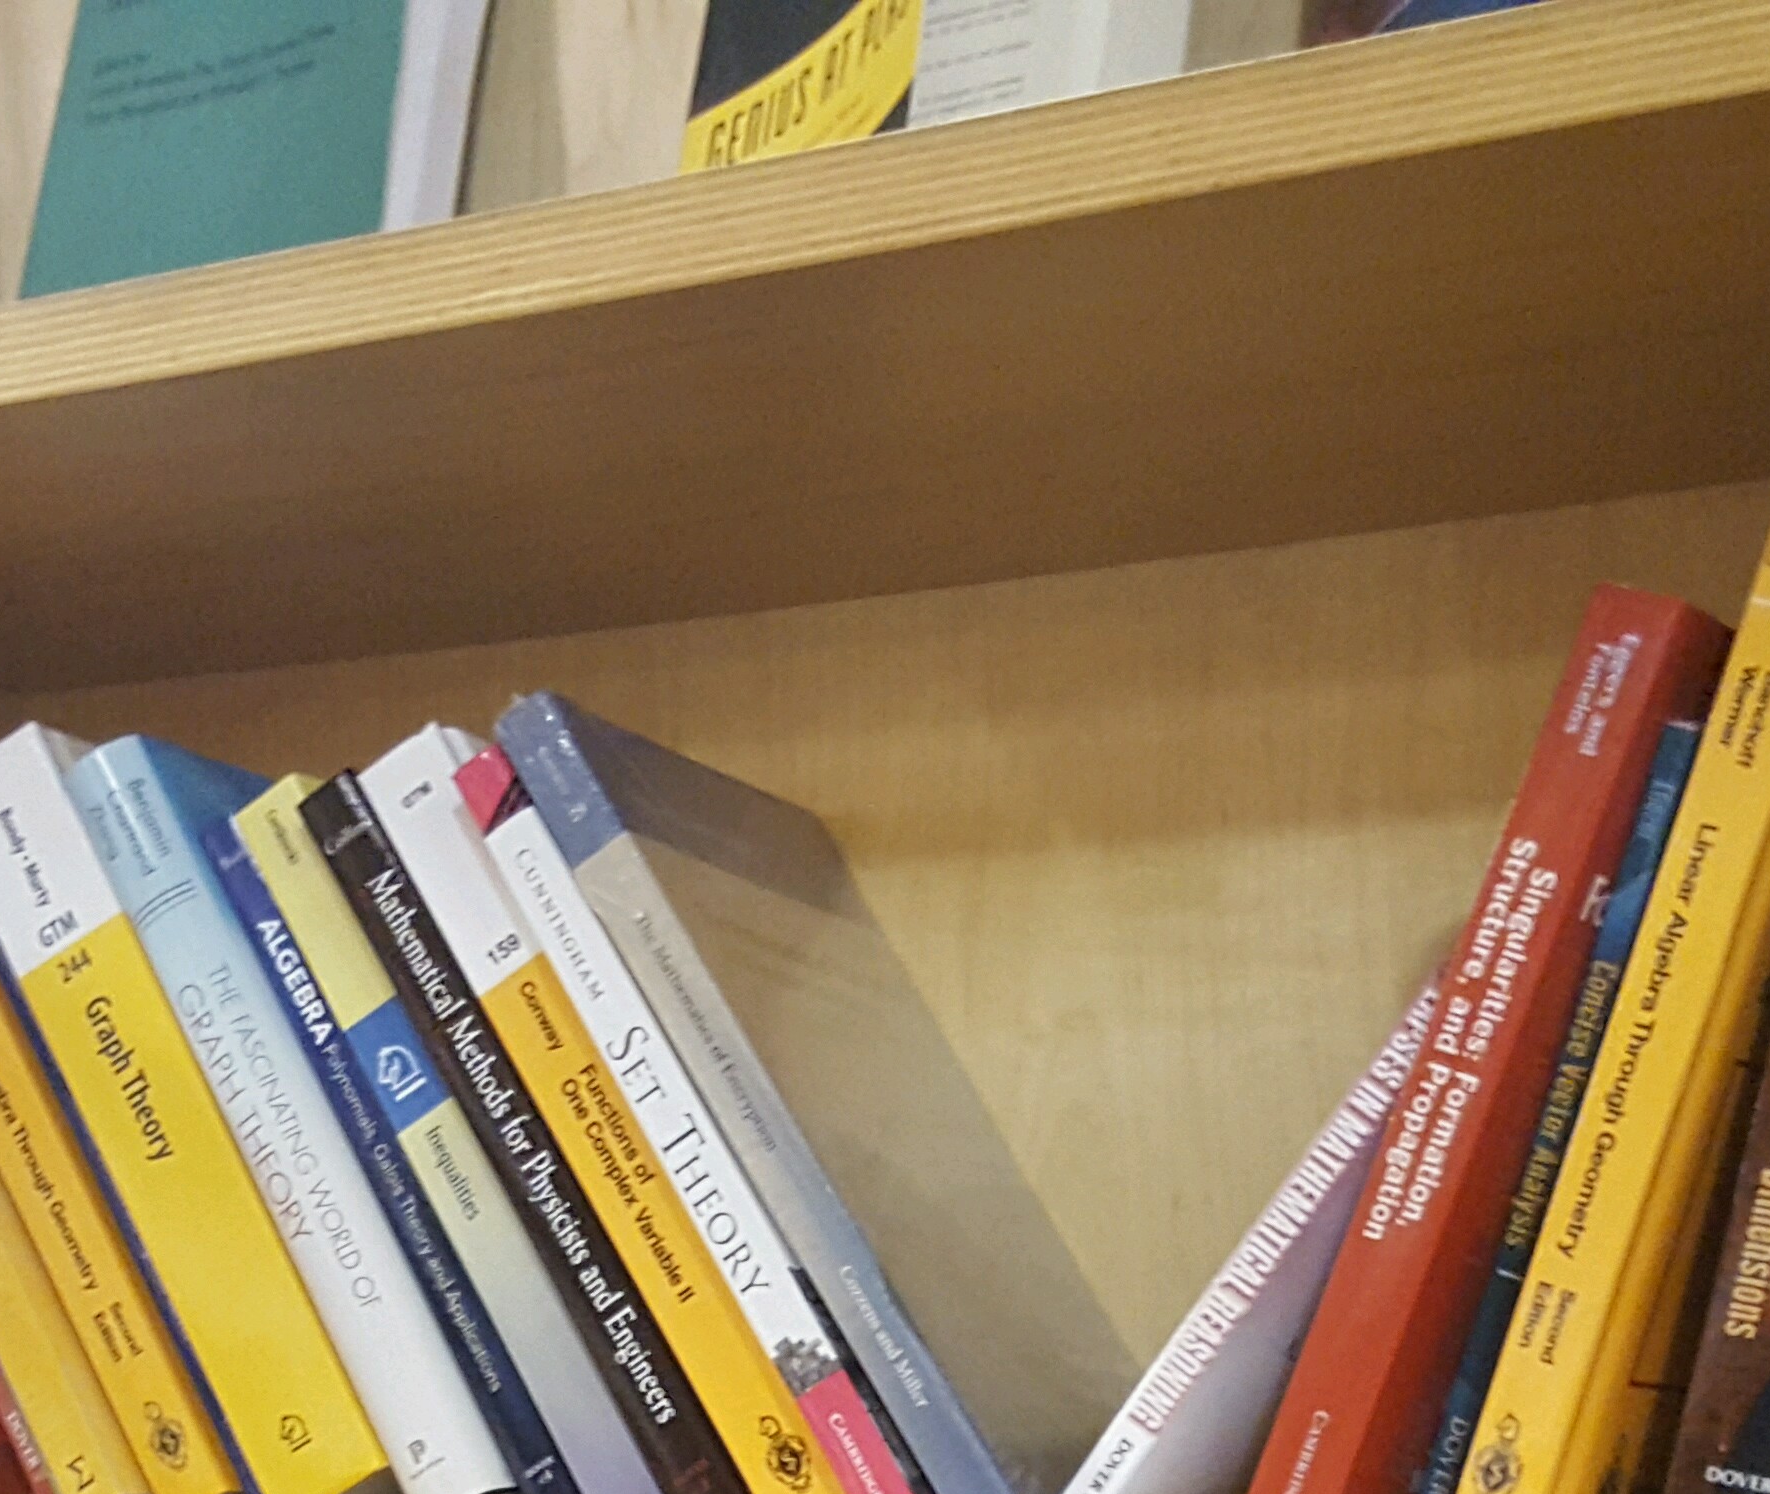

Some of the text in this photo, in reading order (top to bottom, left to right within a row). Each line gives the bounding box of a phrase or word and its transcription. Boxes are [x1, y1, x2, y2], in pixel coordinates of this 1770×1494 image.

[38, 911, 80, 949] GTM
[56, 948, 92, 984] 244
[256, 918, 336, 1047] ALGEBRA
[1464, 868, 1558, 1059] Singularities:
[87, 996, 174, 1163] Graph Theory
[518, 981, 565, 1051] Conway
[1557, 823, 1721, 1260] Linear Algebra Through Geometry
[176, 984, 312, 1241] GRAPH THEORY
[365, 865, 456, 1022] Mathematical
[446, 1010, 514, 1121] Methods
[499, 1114, 532, 1156] for
[520, 1148, 593, 1267] Physicists
[578, 1262, 615, 1312] and
[602, 1303, 678, 1427] Engineers
[426, 1124, 481, 1222] Inequalities
[561, 1078, 684, 1289] One Complex Variable
[578, 1063, 657, 1187] Functions of
[606, 1025, 770, 1299] SET THEORY
[1362, 1000, 1472, 1241] and Propagation
[12, 1122, 54, 1202] Through
[50, 1200, 98, 1290] Geometry
[310, 1180, 360, 1271] WORLD
[1130, 1103, 1373, 1436] MATHEMATICAL REASONING
